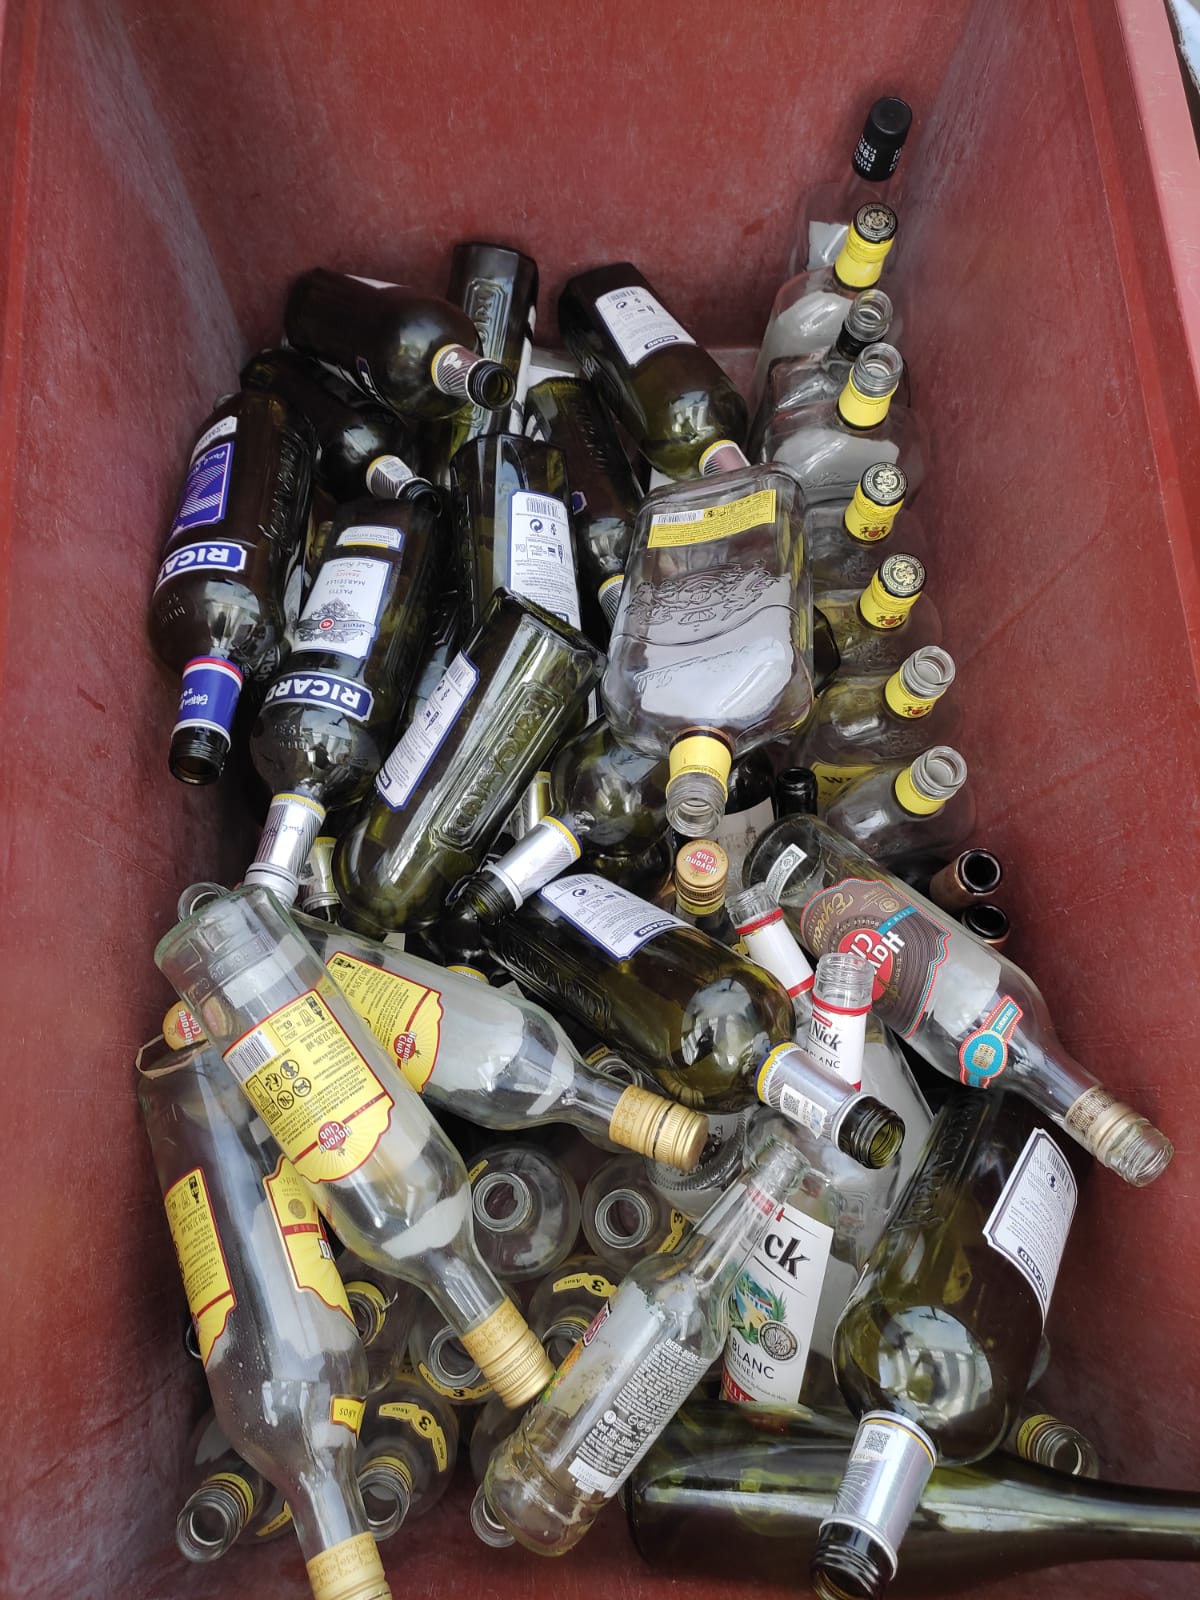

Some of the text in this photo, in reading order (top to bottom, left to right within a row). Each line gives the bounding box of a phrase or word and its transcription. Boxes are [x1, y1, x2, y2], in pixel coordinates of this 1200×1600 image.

[685, 855, 717, 875] Havana
[696, 850, 714, 864] Club
[396, 1035, 407, 1054] Club
[811, 1019, 843, 1052] Nick
[318, 1122, 341, 1141] Club
[318, 1125, 353, 1154] Havana
[731, 1336, 776, 1380] BLANC
[418, 1415, 432, 1432] 3
